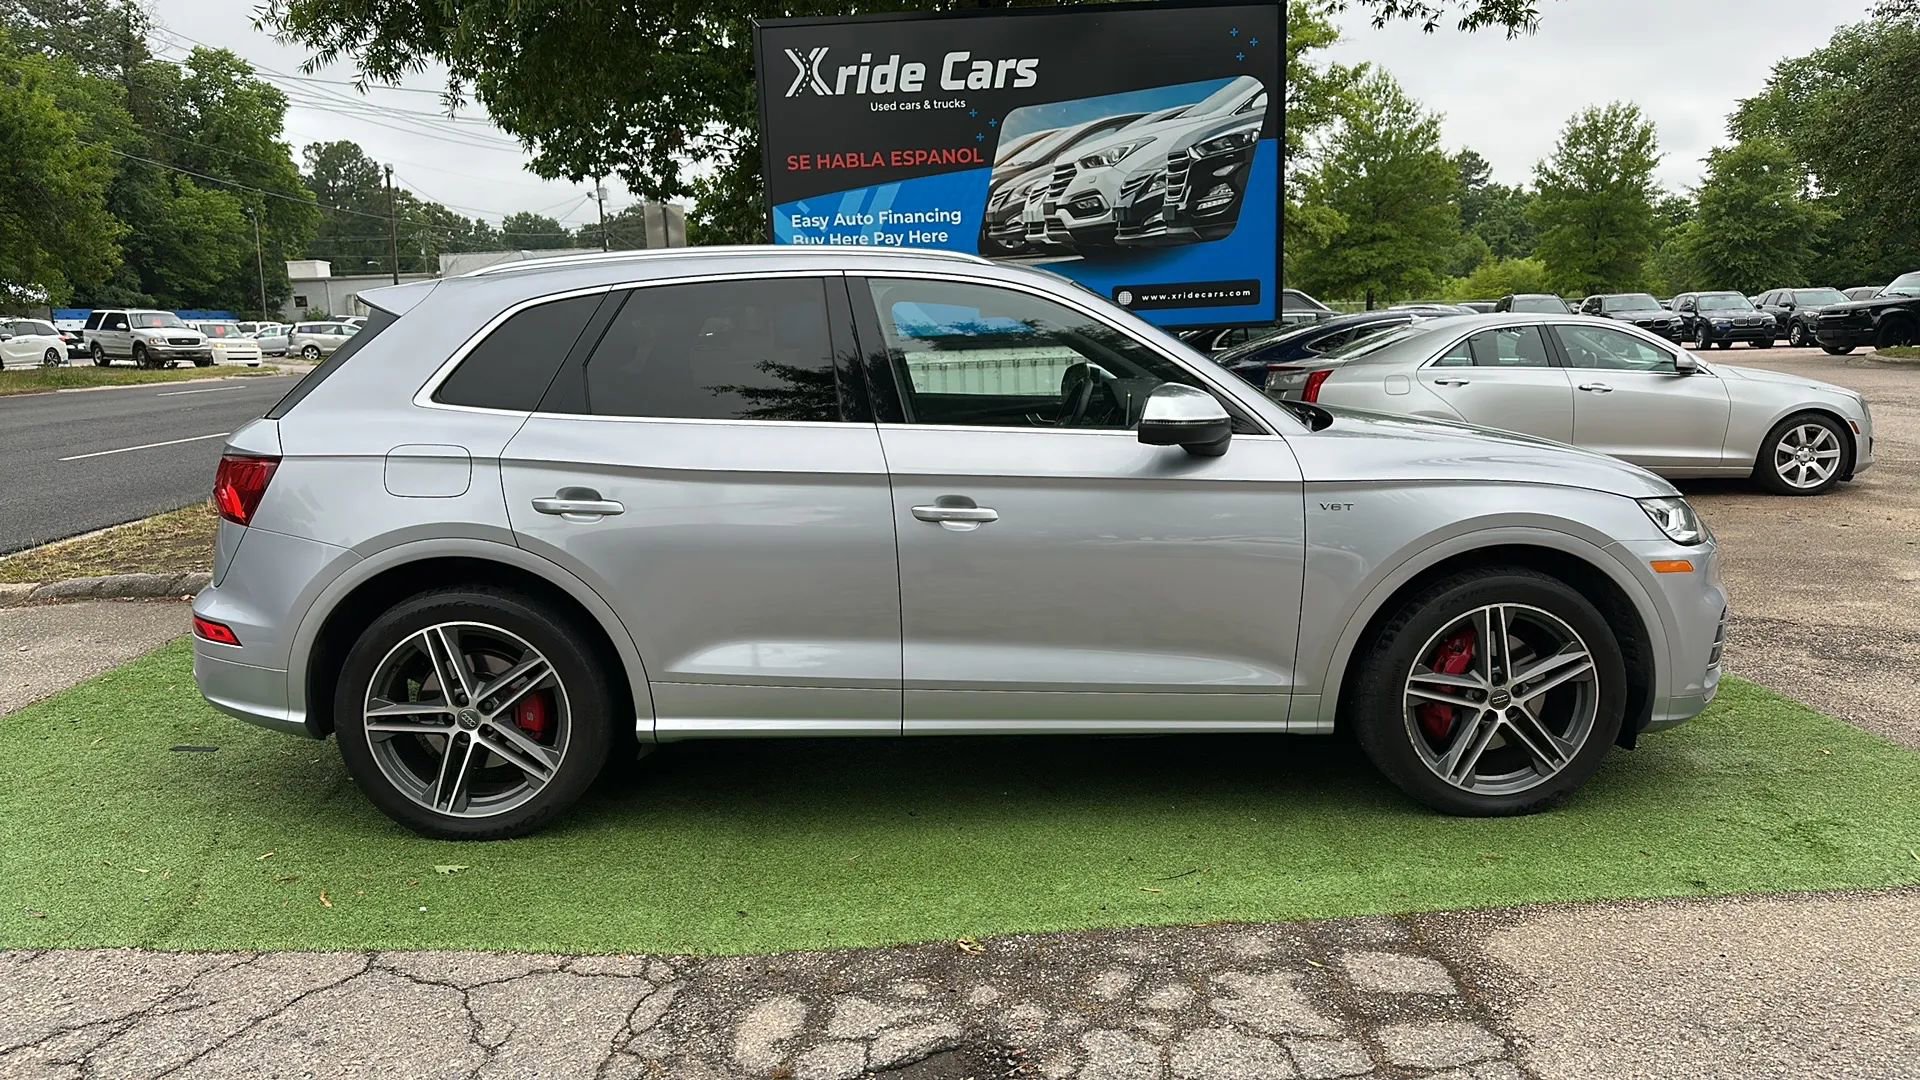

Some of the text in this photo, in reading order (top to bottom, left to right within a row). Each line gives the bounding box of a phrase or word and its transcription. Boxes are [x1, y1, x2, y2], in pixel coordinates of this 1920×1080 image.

[939, 51, 1040, 92] Cars
[870, 98, 967, 112] Used cars & trucks
[787, 147, 985, 171] SE HABLA ESPANOL
[791, 207, 962, 230] Easy Auto Financing
[829, 232, 869, 246] Here
[873, 230, 904, 247] Pay
[908, 229, 949, 244] Here
[1141, 289, 1252, 302] www.xridecars.com
[1319, 502, 1355, 511] V6T
